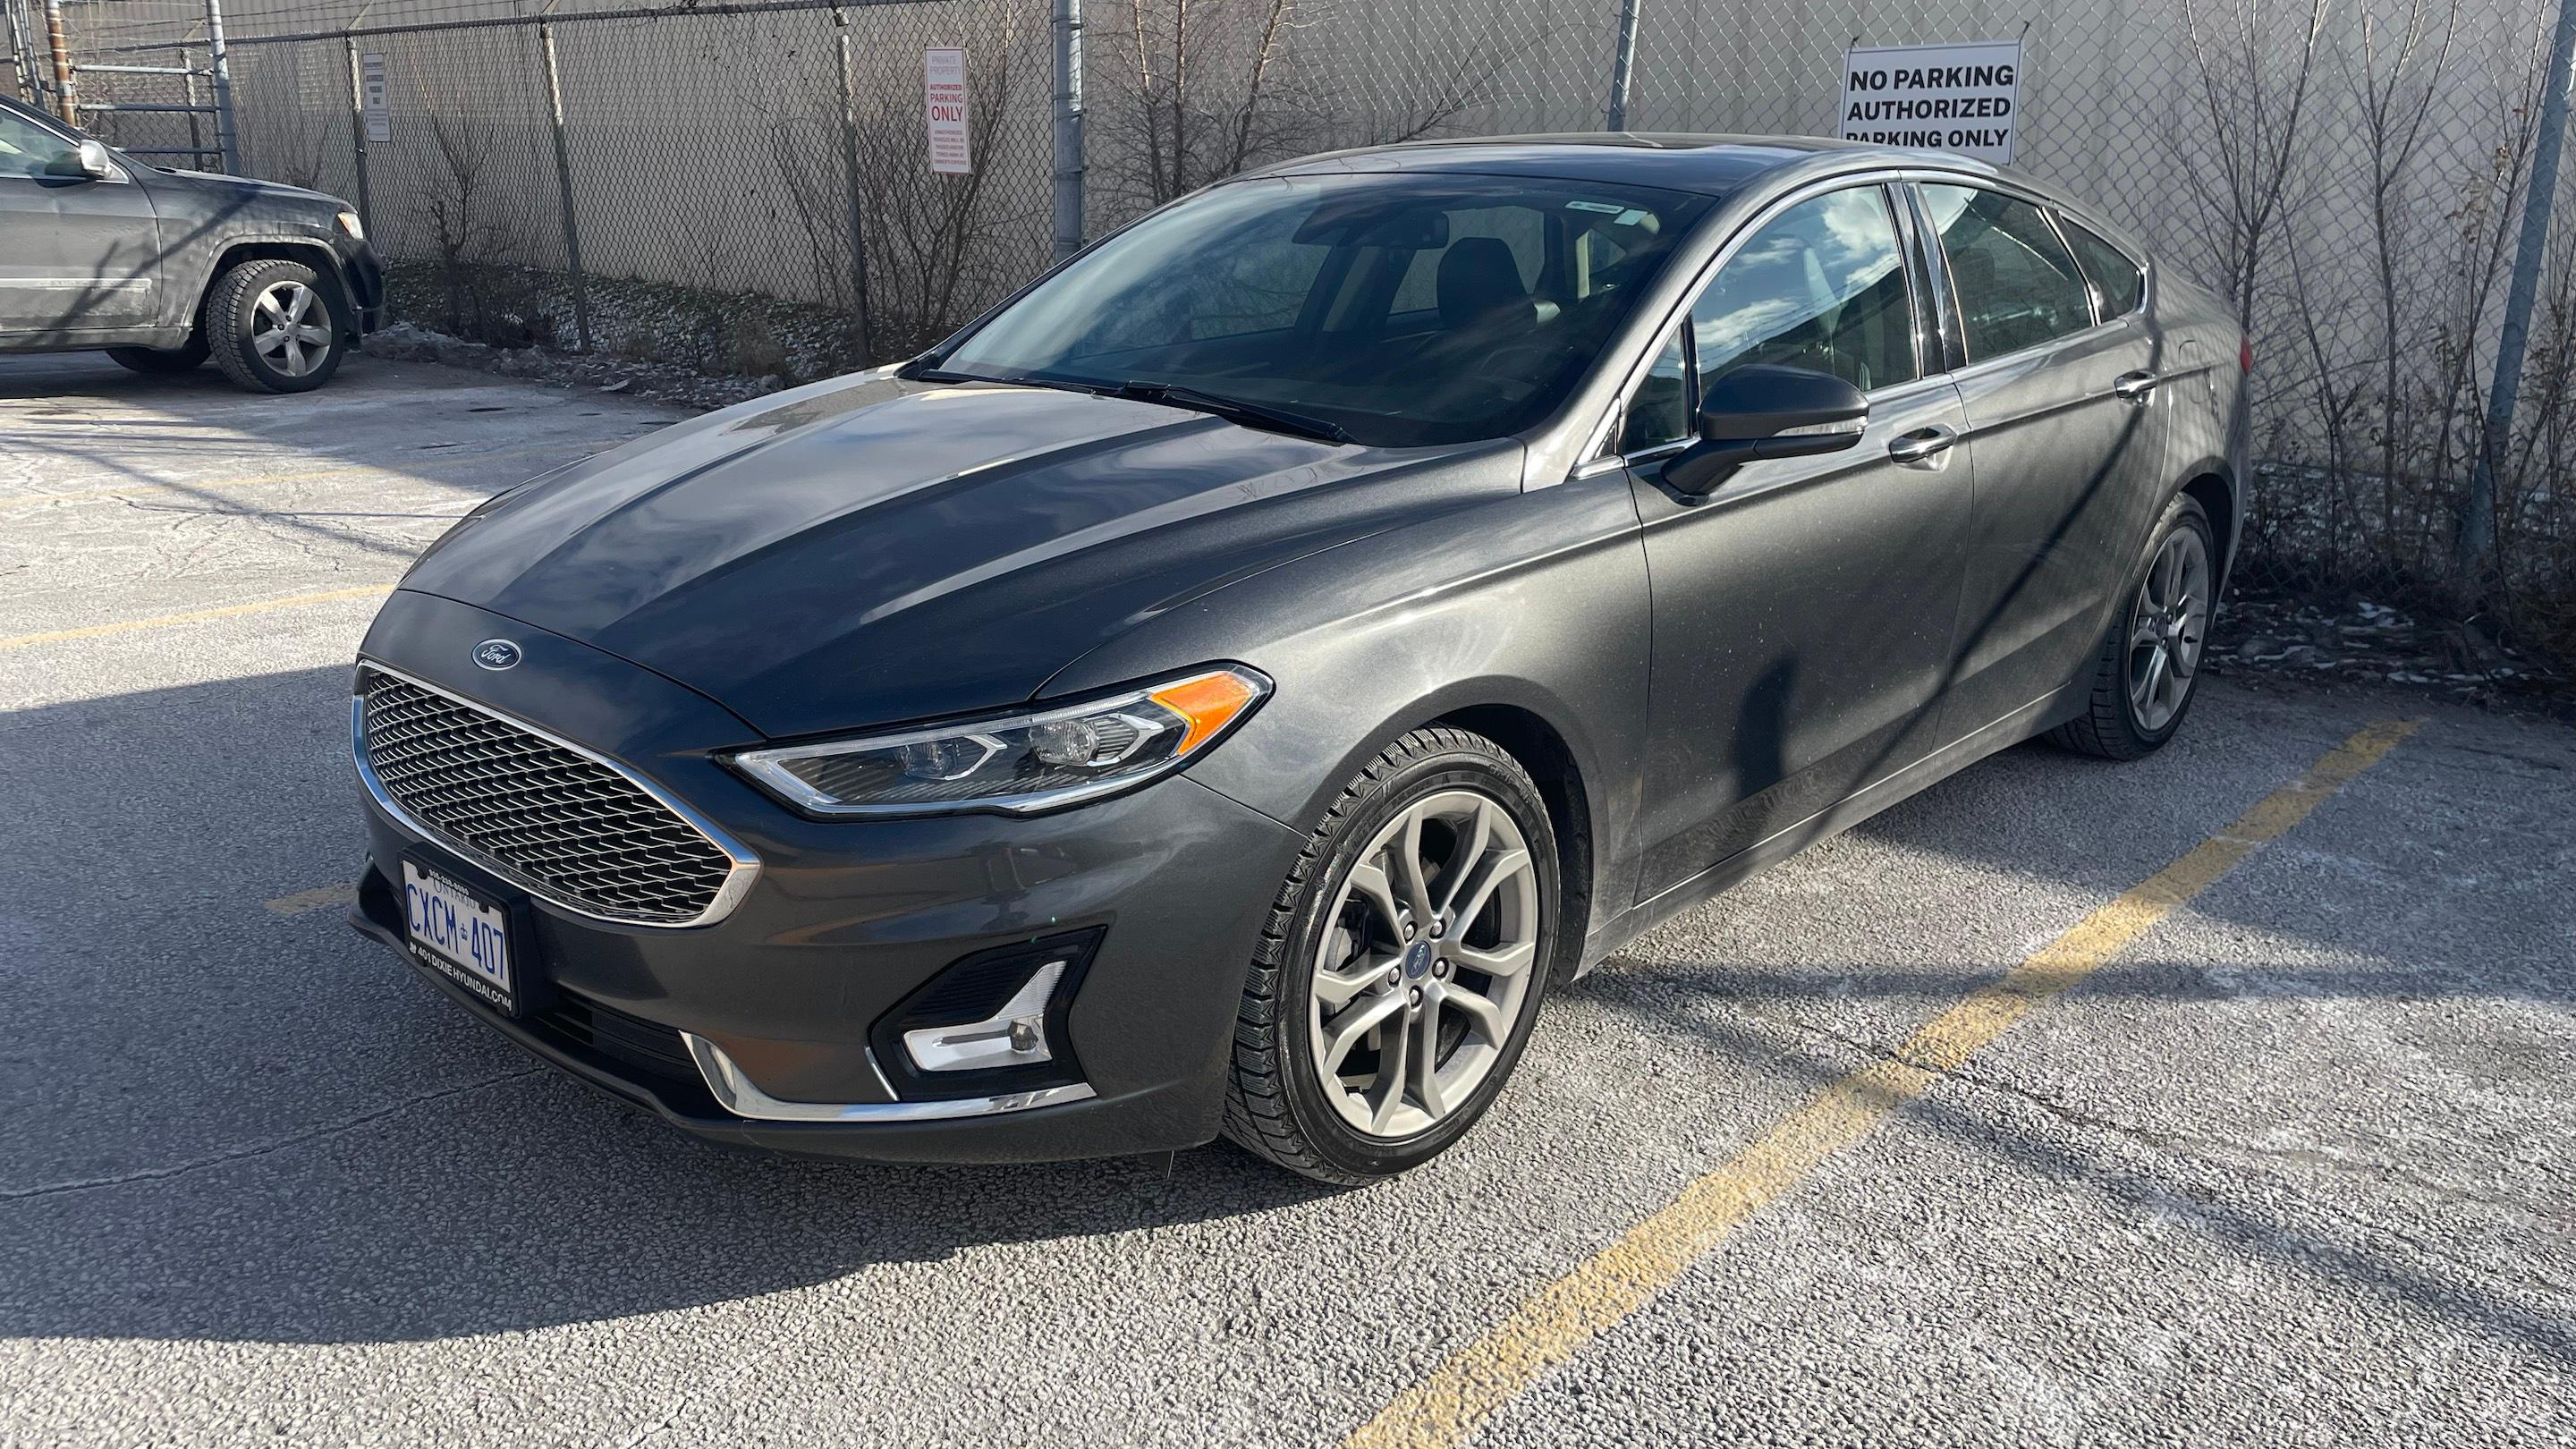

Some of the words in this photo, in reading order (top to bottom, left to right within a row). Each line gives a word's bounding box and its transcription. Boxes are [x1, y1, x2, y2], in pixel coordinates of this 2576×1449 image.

[932, 55, 956, 65] PRIVATE
[929, 66, 961, 76] PROPERTY
[1850, 71, 1887, 91] NO
[1894, 65, 2013, 89] PARKING
[930, 93, 963, 104] PARKING
[931, 106, 963, 122] ONLY
[1847, 97, 2011, 121] AUTHORIZED
[1948, 129, 2009, 148] ONLY
[481, 644, 512, 665] Ford
[405, 883, 459, 955] CXCM
[471, 917, 504, 980] 407
[431, 954, 453, 978] DIXIE
[453, 967, 513, 1013] HYUNDAI.COM
